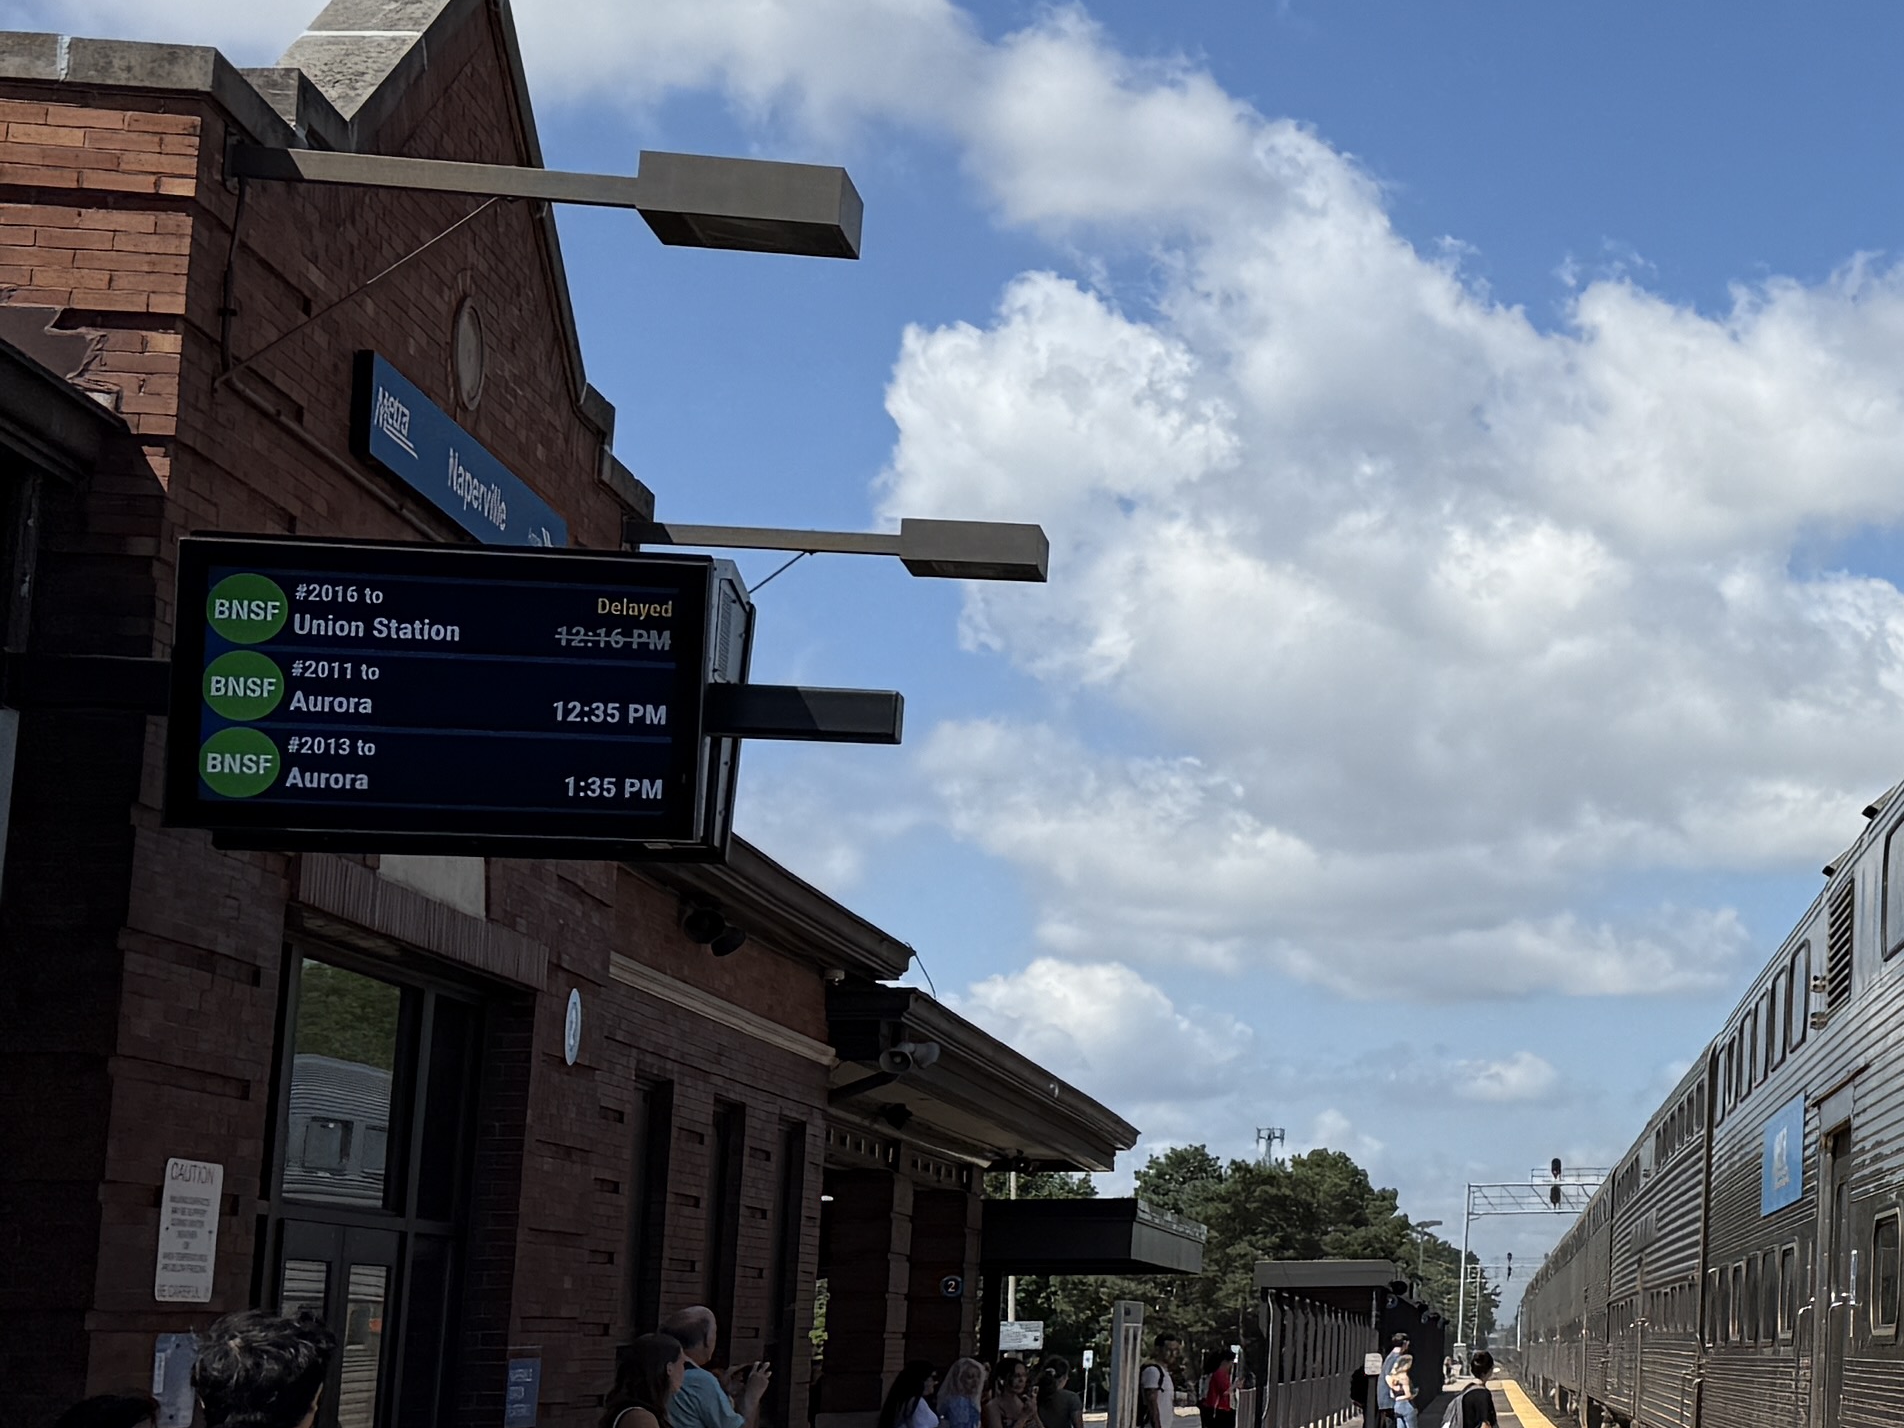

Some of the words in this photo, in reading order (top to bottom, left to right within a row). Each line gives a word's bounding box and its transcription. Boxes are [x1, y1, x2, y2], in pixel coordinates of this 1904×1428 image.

[374, 387, 412, 440] Metra
[448, 448, 507, 531] Naperville
[295, 584, 358, 602] #2016
[365, 587, 384, 604] to
[214, 599, 281, 621] BNSF
[597, 598, 673, 620] Delayed
[293, 613, 364, 637] Union
[372, 618, 460, 641] Station
[556, 626, 625, 648] 12:16
[631, 629, 671, 651] PM
[291, 660, 352, 679] #2011
[360, 664, 380, 680] to
[210, 676, 277, 697] BNSF
[289, 690, 372, 713] Aurora
[553, 701, 620, 723] 12:35
[628, 704, 667, 725] PM
[287, 736, 350, 755] #2013
[357, 740, 376, 756] to
[206, 753, 273, 774] BNSF
[286, 767, 369, 789] Aurora
[565, 776, 616, 798] 1:35
[624, 778, 663, 799] PM
[170, 1161, 215, 1185] CAUTION
[947, 1280, 956, 1293] 2
